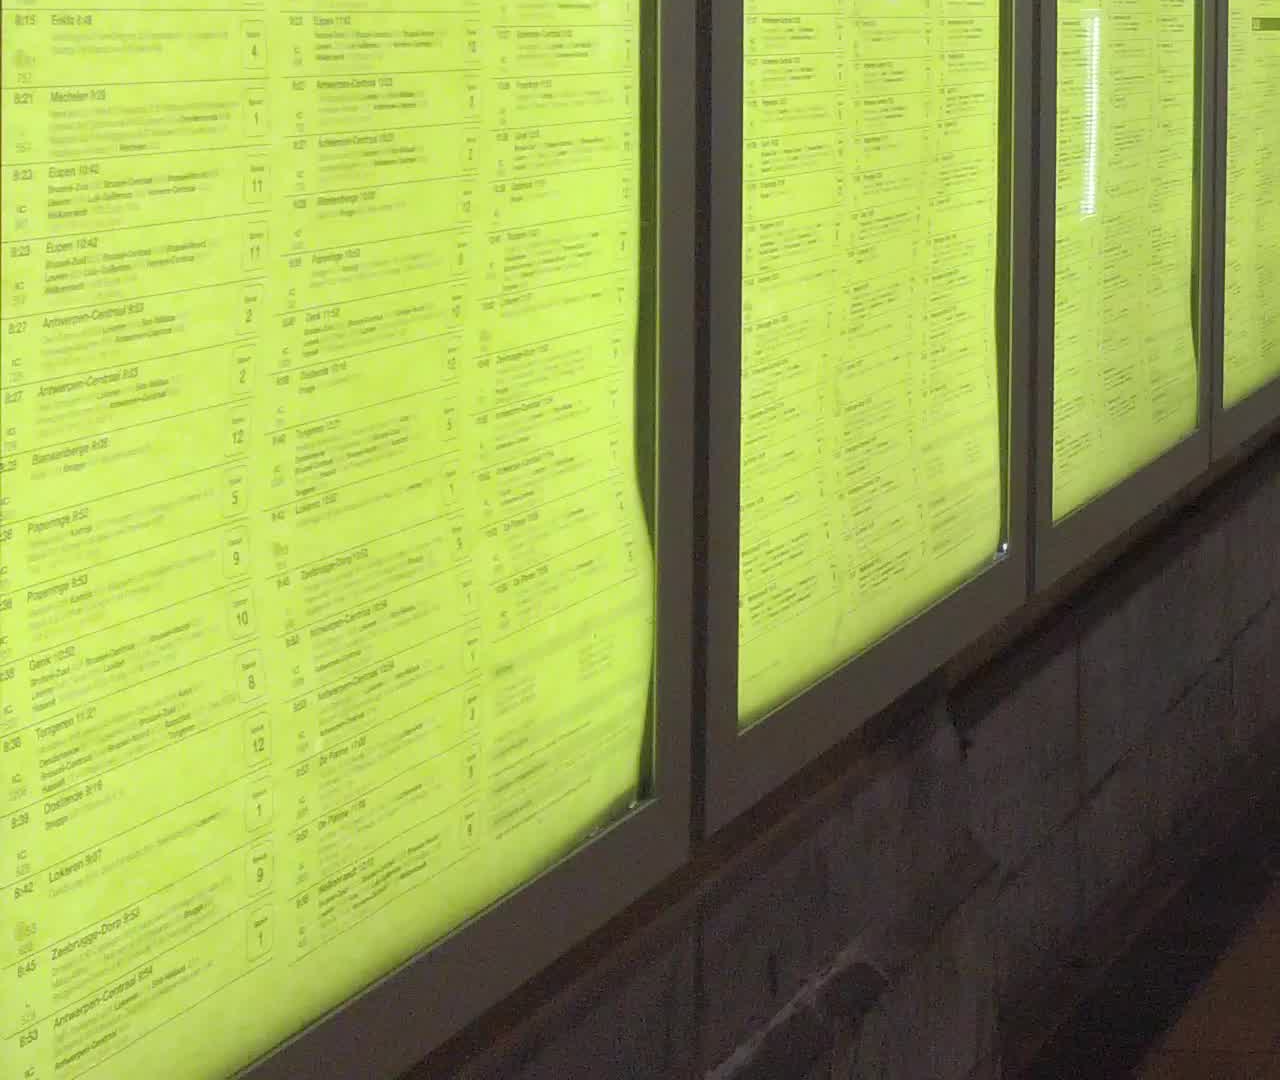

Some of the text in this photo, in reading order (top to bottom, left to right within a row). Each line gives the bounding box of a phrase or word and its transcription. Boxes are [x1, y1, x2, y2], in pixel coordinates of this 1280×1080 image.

[48, 166, 76, 179] Eupen
[11, 245, 31, 257] 8:23
[46, 242, 73, 255] Eupen
[43, 305, 126, 329] Antwerpen-Centraal
[38, 373, 121, 397] Antwerpen-Centraal
[35, 717, 74, 740] Tongeren
[49, 863, 84, 884] Lokeren
[17, 918, 122, 978] 8:45 Zeebrugge-Dorp
[19, 1029, 39, 1048] 8:50
[53, 975, 136, 1030] Antwerpen-Centraal
